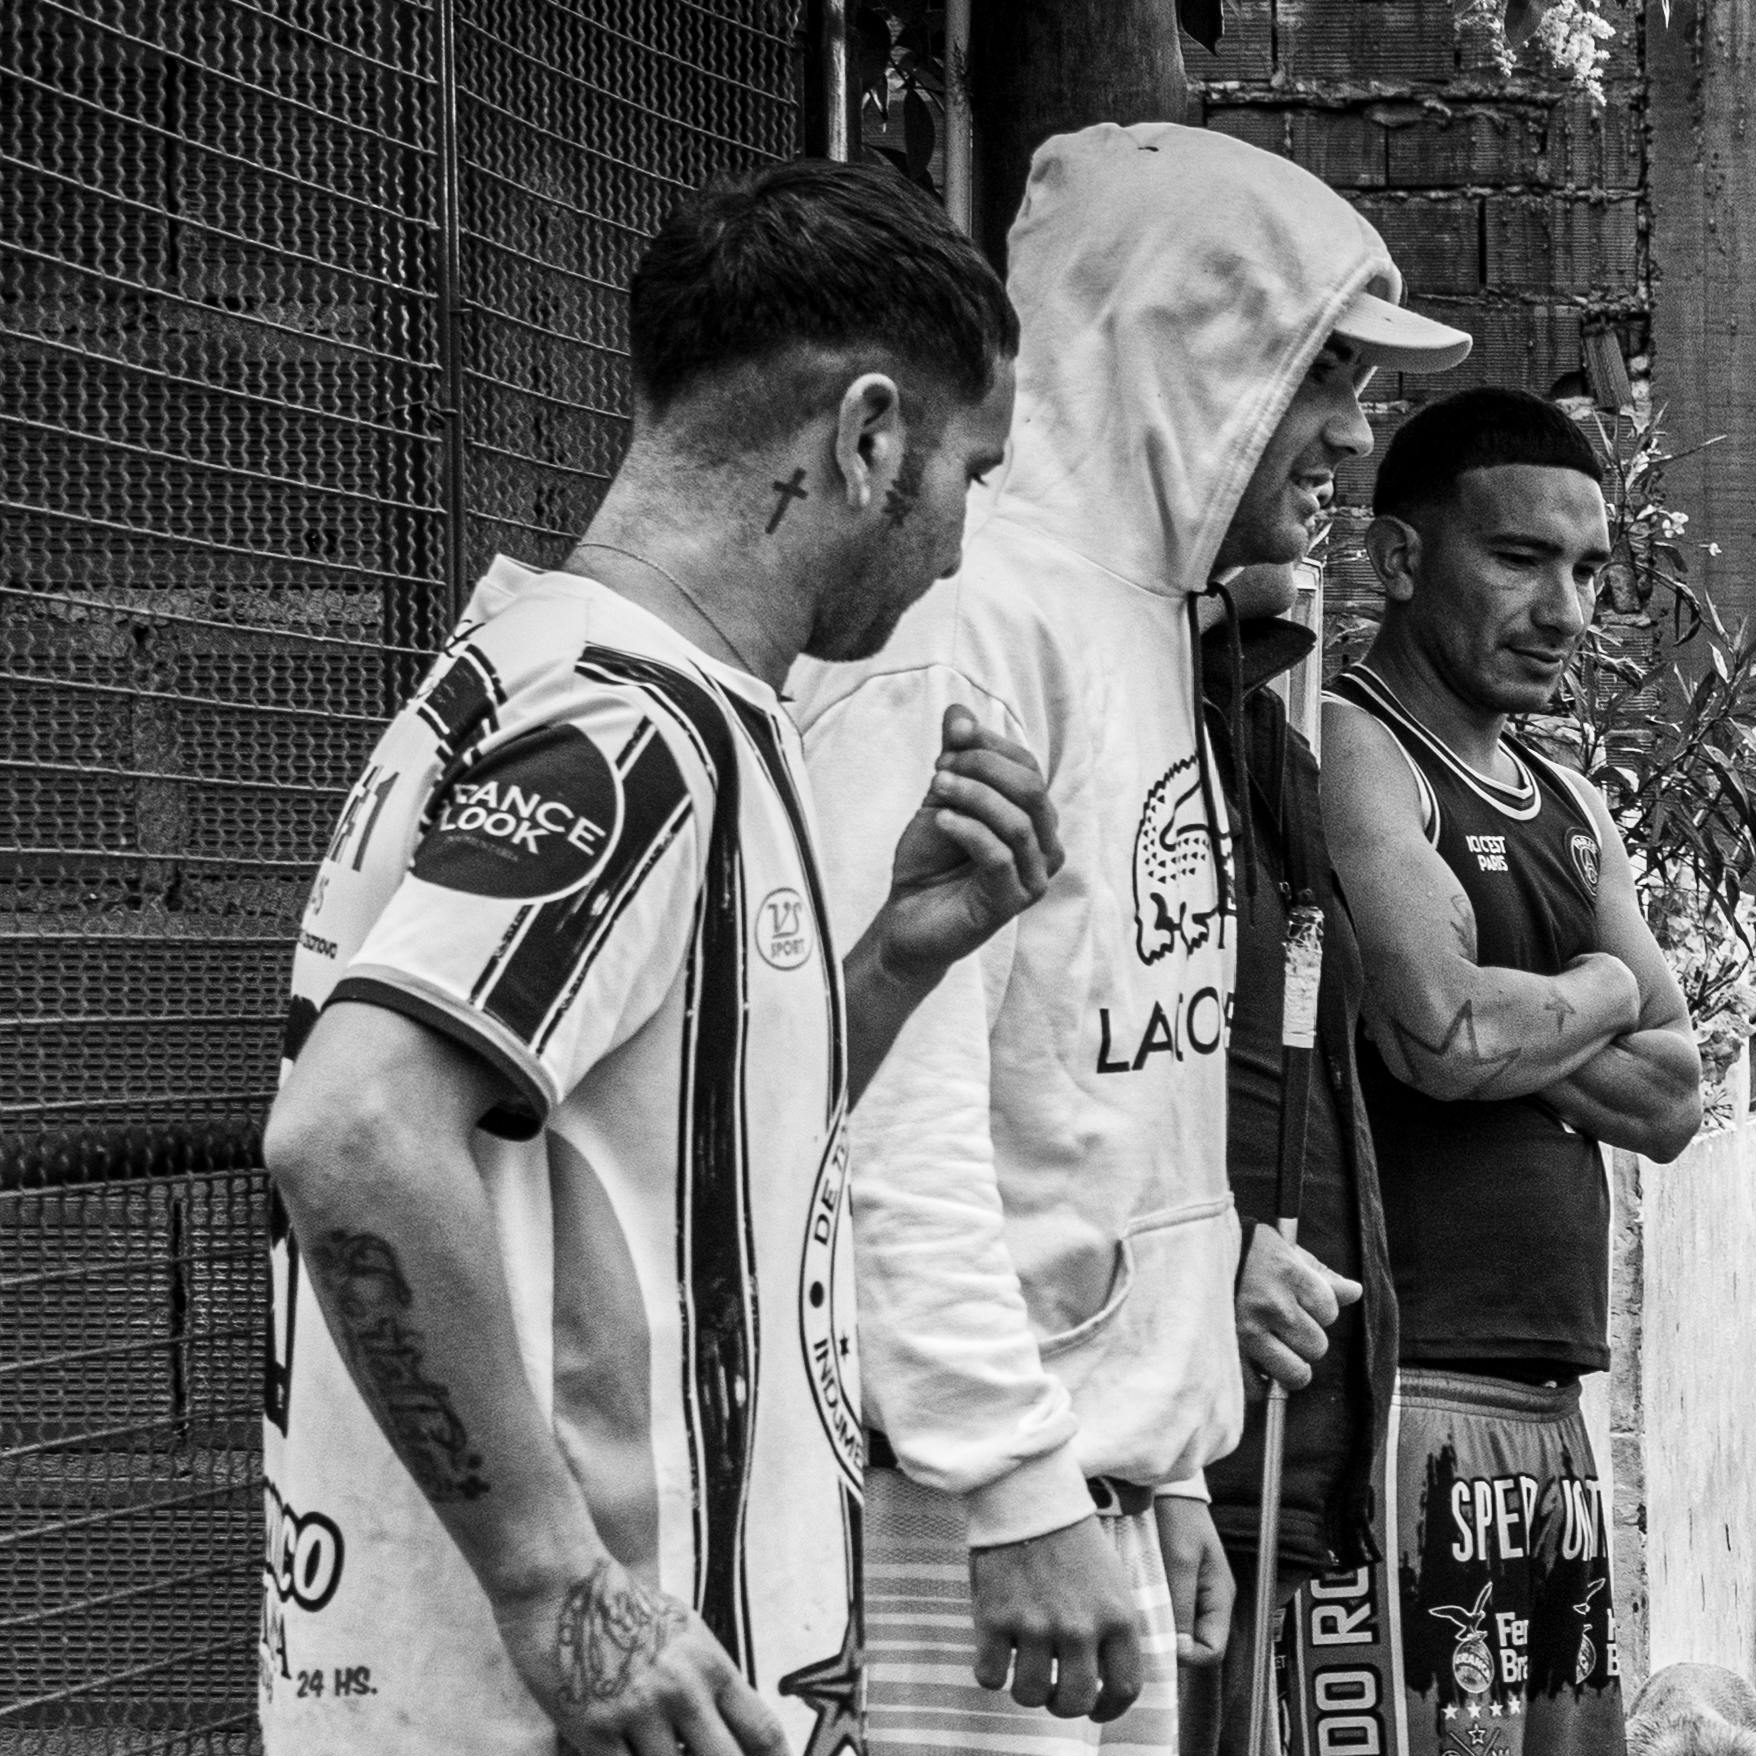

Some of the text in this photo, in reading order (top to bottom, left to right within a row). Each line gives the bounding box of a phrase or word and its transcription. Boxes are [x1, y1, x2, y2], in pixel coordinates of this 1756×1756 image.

[440, 800, 551, 854] LOOK
[297, 1665, 378, 1698] 24 HS.
